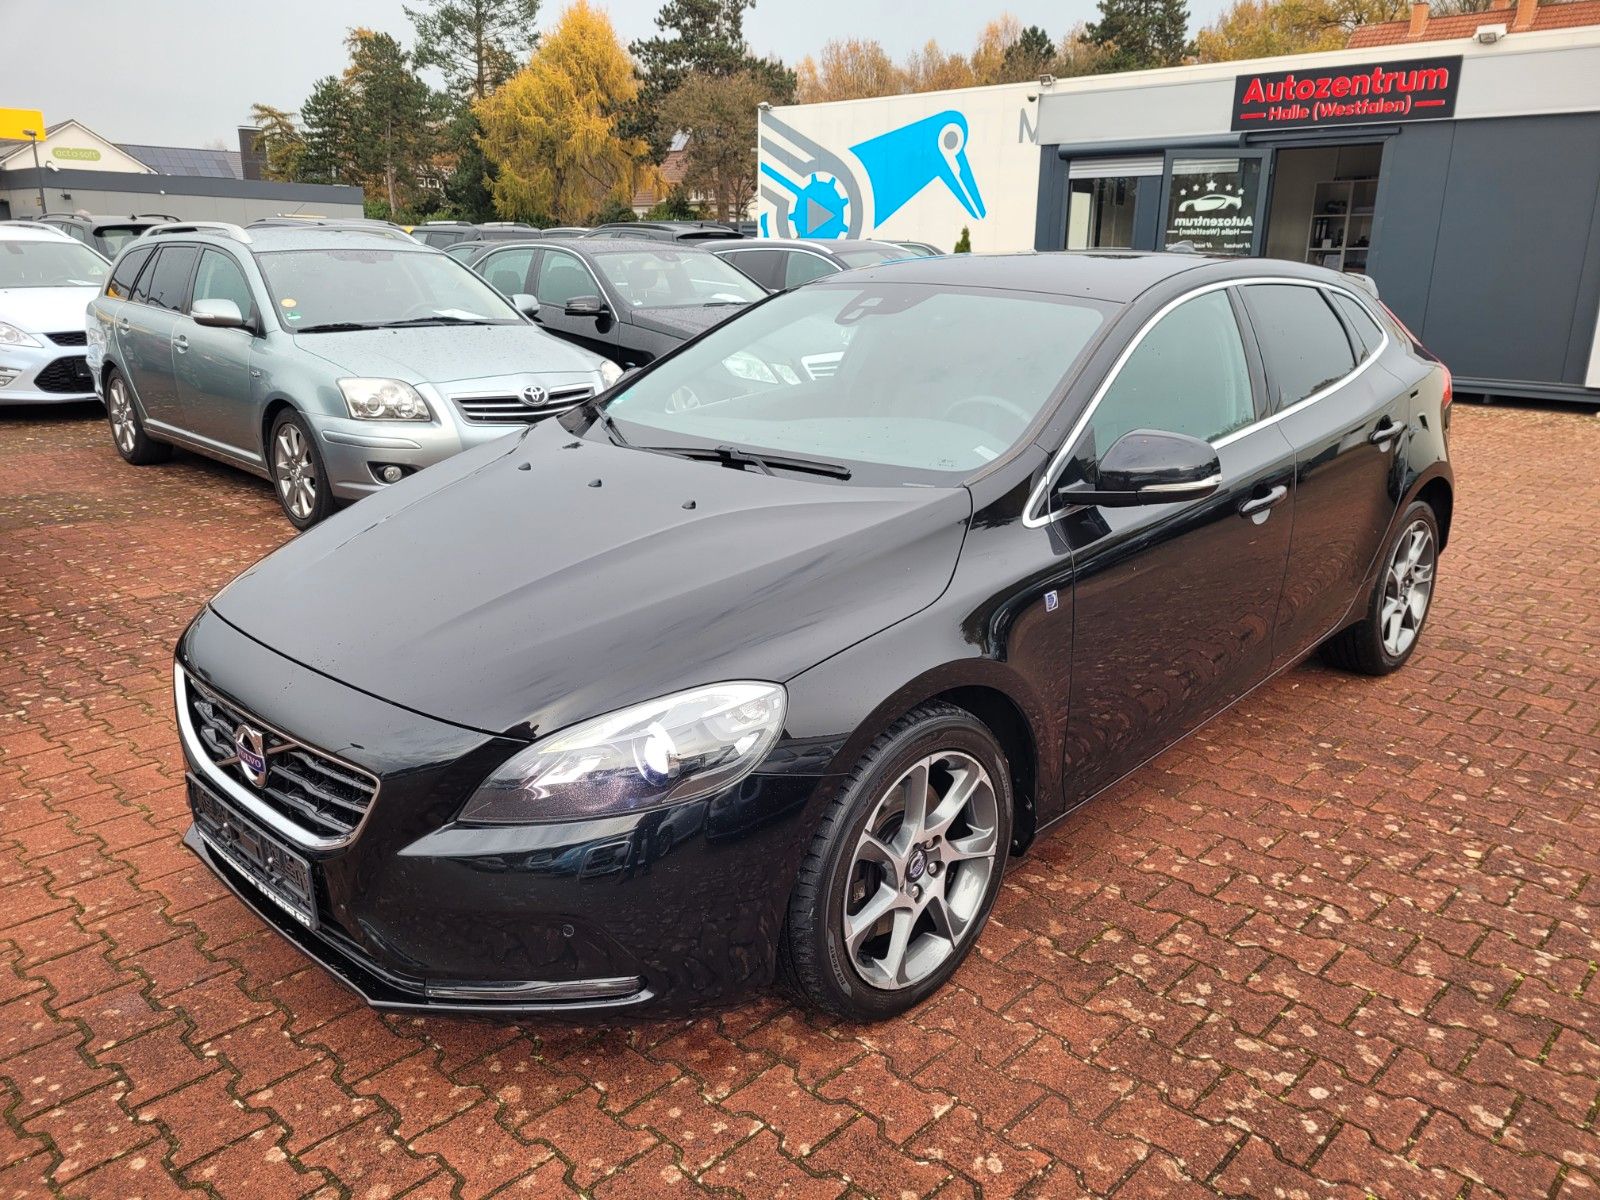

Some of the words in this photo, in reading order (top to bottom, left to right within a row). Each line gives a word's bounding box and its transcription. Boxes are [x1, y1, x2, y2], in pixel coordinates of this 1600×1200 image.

[1242, 66, 1450, 105] Autozentrum
[1268, 105, 1310, 121] Halle
[1312, 95, 1412, 121] (Westfalen)
